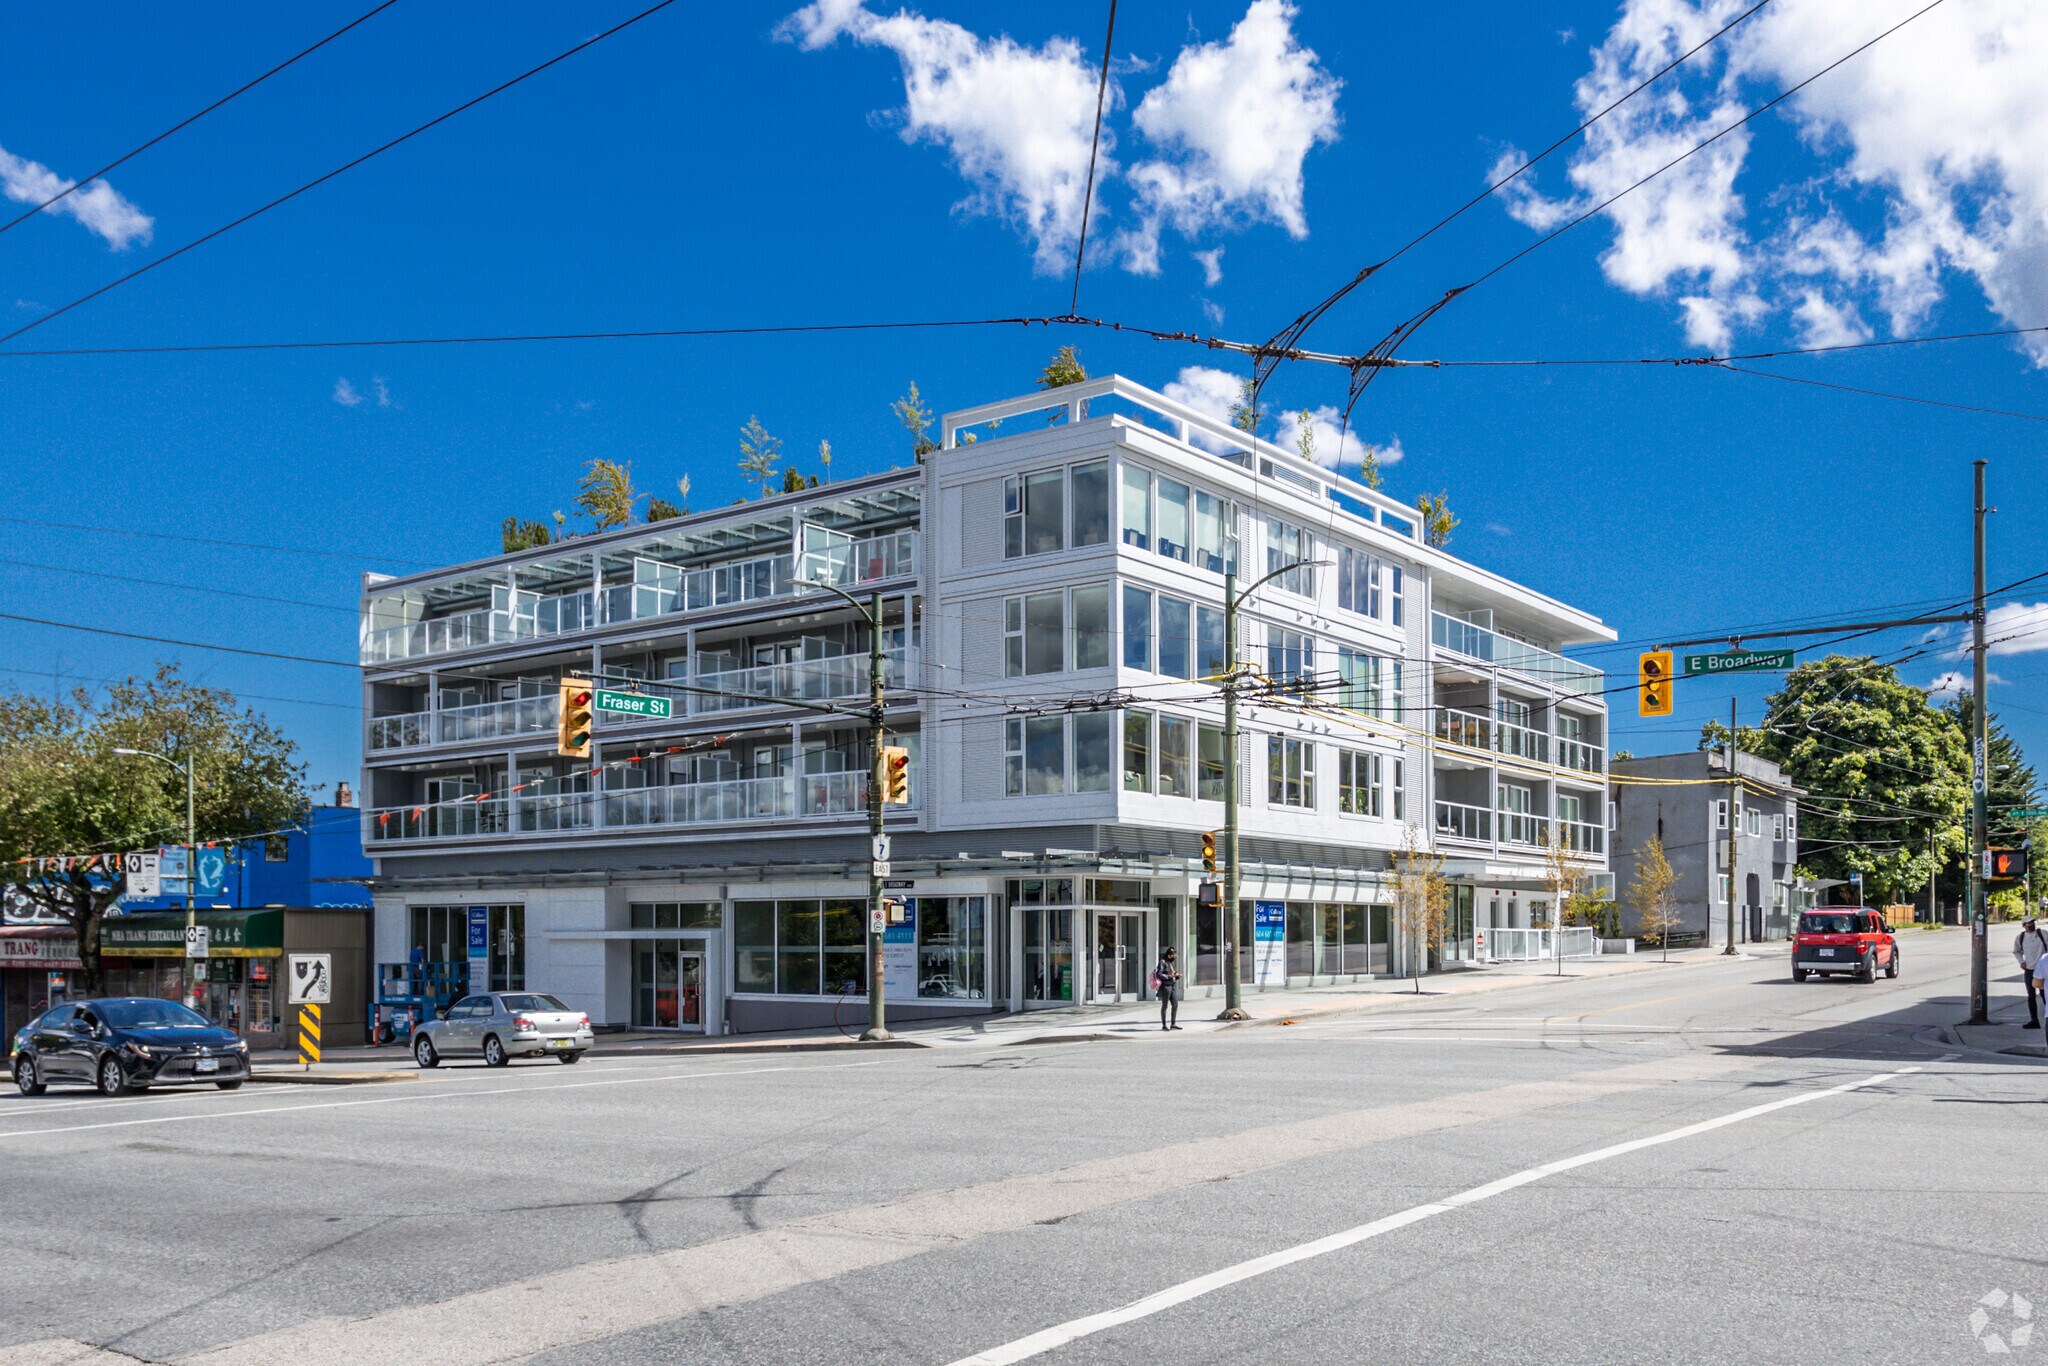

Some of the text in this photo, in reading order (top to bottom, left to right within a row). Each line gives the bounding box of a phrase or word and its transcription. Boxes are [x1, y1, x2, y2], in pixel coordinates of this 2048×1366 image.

[1691, 653, 1785, 670] E Broadway
[602, 694, 664, 714] Fraser St
[879, 843, 885, 855] 7
[875, 864, 889, 874] EAST
[1256, 904, 1265, 912] For
[1256, 914, 1267, 923] Sale
[111, 930, 187, 941] NHA TRANG RESTAURAN
[471, 926, 481, 935] For
[471, 936, 484, 945] Sale
[896, 932, 912, 940] 4111
[4, 941, 38, 955] TRANG
